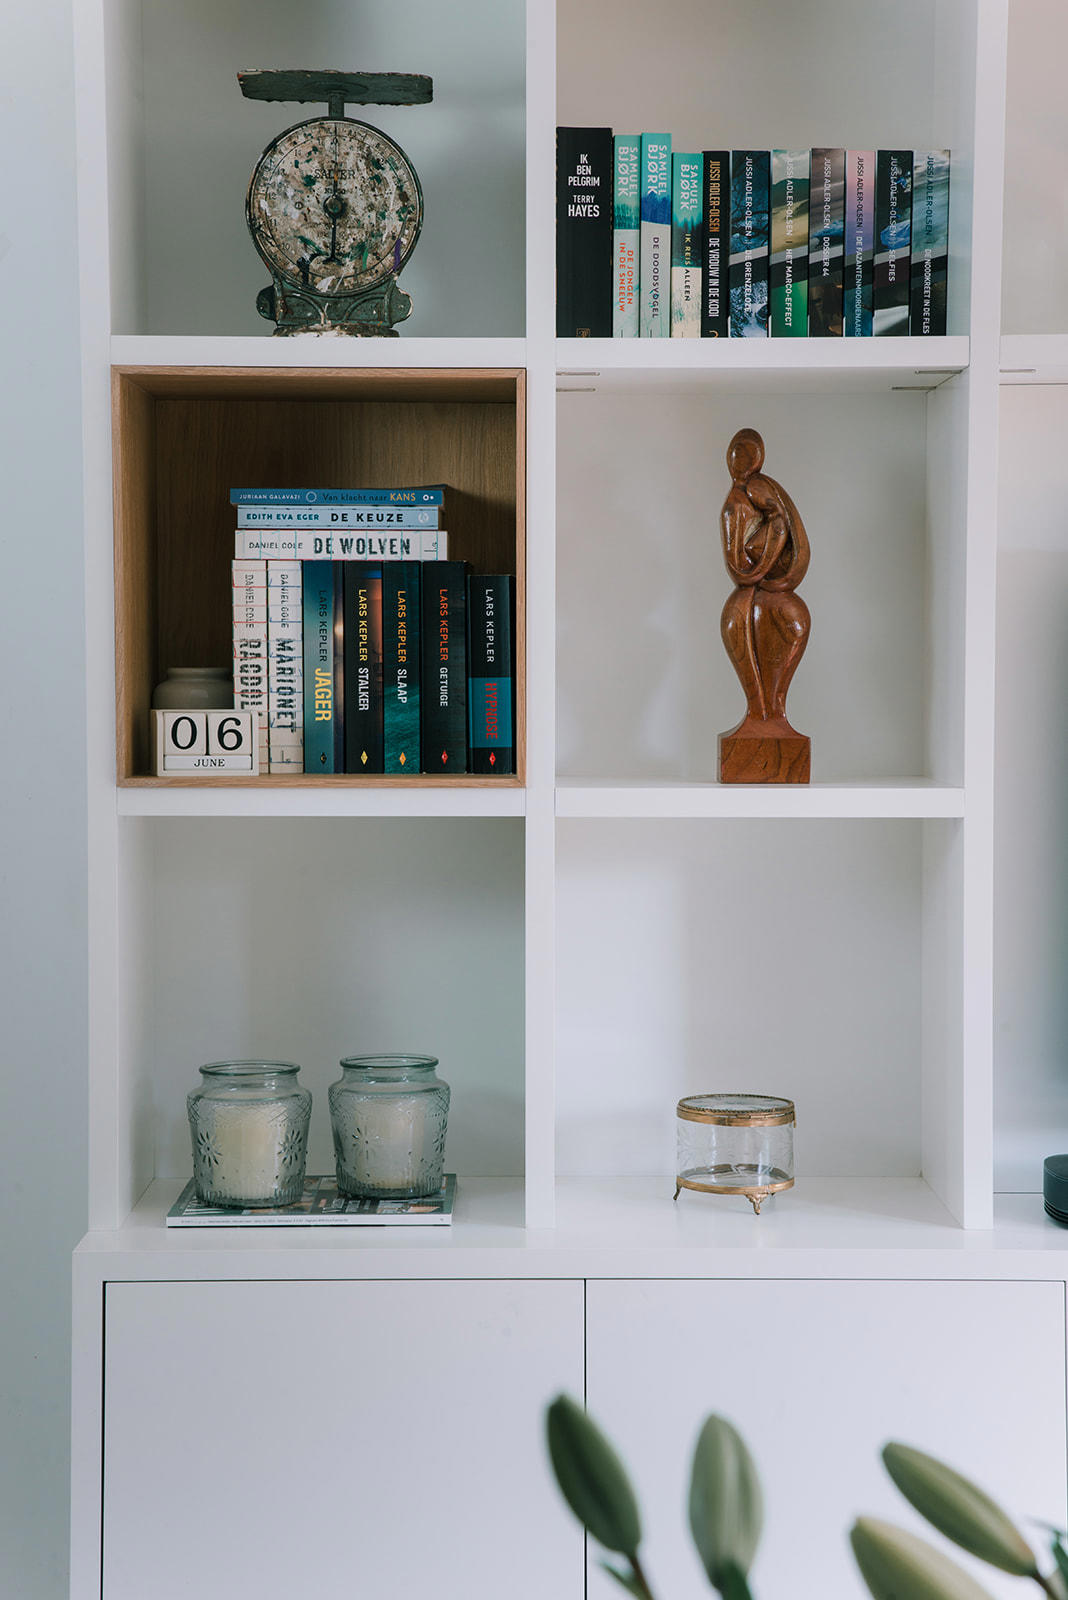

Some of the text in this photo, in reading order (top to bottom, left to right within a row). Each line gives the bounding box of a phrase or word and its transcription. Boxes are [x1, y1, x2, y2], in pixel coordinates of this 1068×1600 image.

[576, 165, 591, 175] BEN
[580, 154, 588, 164] IK
[647, 144, 658, 194] BJØRK
[658, 144, 667, 196] SAMUEL
[745, 156, 753, 179] JUSSI
[823, 157, 831, 178] JUSSI
[856, 156, 864, 178] JUSSI
[890, 156, 898, 179] JUSSI
[926, 156, 934, 178] JUSSI
[314, 169, 355, 179] SALER
[568, 176, 600, 187] PELGRIM
[618, 146, 629, 197] BJØRK
[629, 147, 638, 197] SAMUEL
[709, 160, 720, 181] JUSSI
[680, 164, 690, 210] BJØRK
[690, 164, 698, 211] SAMUEL
[573, 195, 595, 203] TERRY
[568, 204, 600, 217] HAYES
[619, 242, 626, 253] IN
[685, 233, 692, 243] IK
[708, 238, 720, 247] DE
[856, 236, 863, 247] DE
[619, 257, 626, 268] DE
[627, 250, 634, 262] DE
[709, 248, 720, 277] VROUW
[745, 249, 752, 261] DE
[785, 249, 793, 264] HET
[822, 236, 830, 277] DOSSIER 64
[925, 248, 932, 258] DE
[888, 249, 896, 282] SELFIES
[652, 237, 660, 318] DE DOODSVOGEL
[923, 259, 932, 298] NOODKREET
[708, 288, 719, 297] DE
[708, 299, 719, 317] KOOI
[922, 307, 930, 316] DE
[922, 318, 930, 334] FLES
[322, 493, 338, 501] Van
[390, 492, 416, 501] KANS
[331, 513, 404, 522] DE KEUZE
[314, 537, 410, 555] DE WOLVEN
[245, 574, 254, 628] DANIEL COLE
[280, 574, 289, 628] DANIEL COLE
[318, 590, 328, 662] LARS KEPLER
[358, 589, 368, 661] LARS KEPLER
[397, 590, 407, 663] LARS KEPLER
[439, 589, 449, 661] LARS KEPLER
[485, 589, 494, 663] LARS KEPLER
[240, 638, 262, 716] RAGDOL
[275, 637, 297, 733] MARIONET
[397, 668, 407, 704] SLAAP
[439, 667, 448, 707] GETUIGE
[314, 668, 332, 721] JAGER
[358, 667, 369, 711] STALKER
[485, 683, 498, 740] HYPNOSE
[194, 759, 225, 768] JUNE
